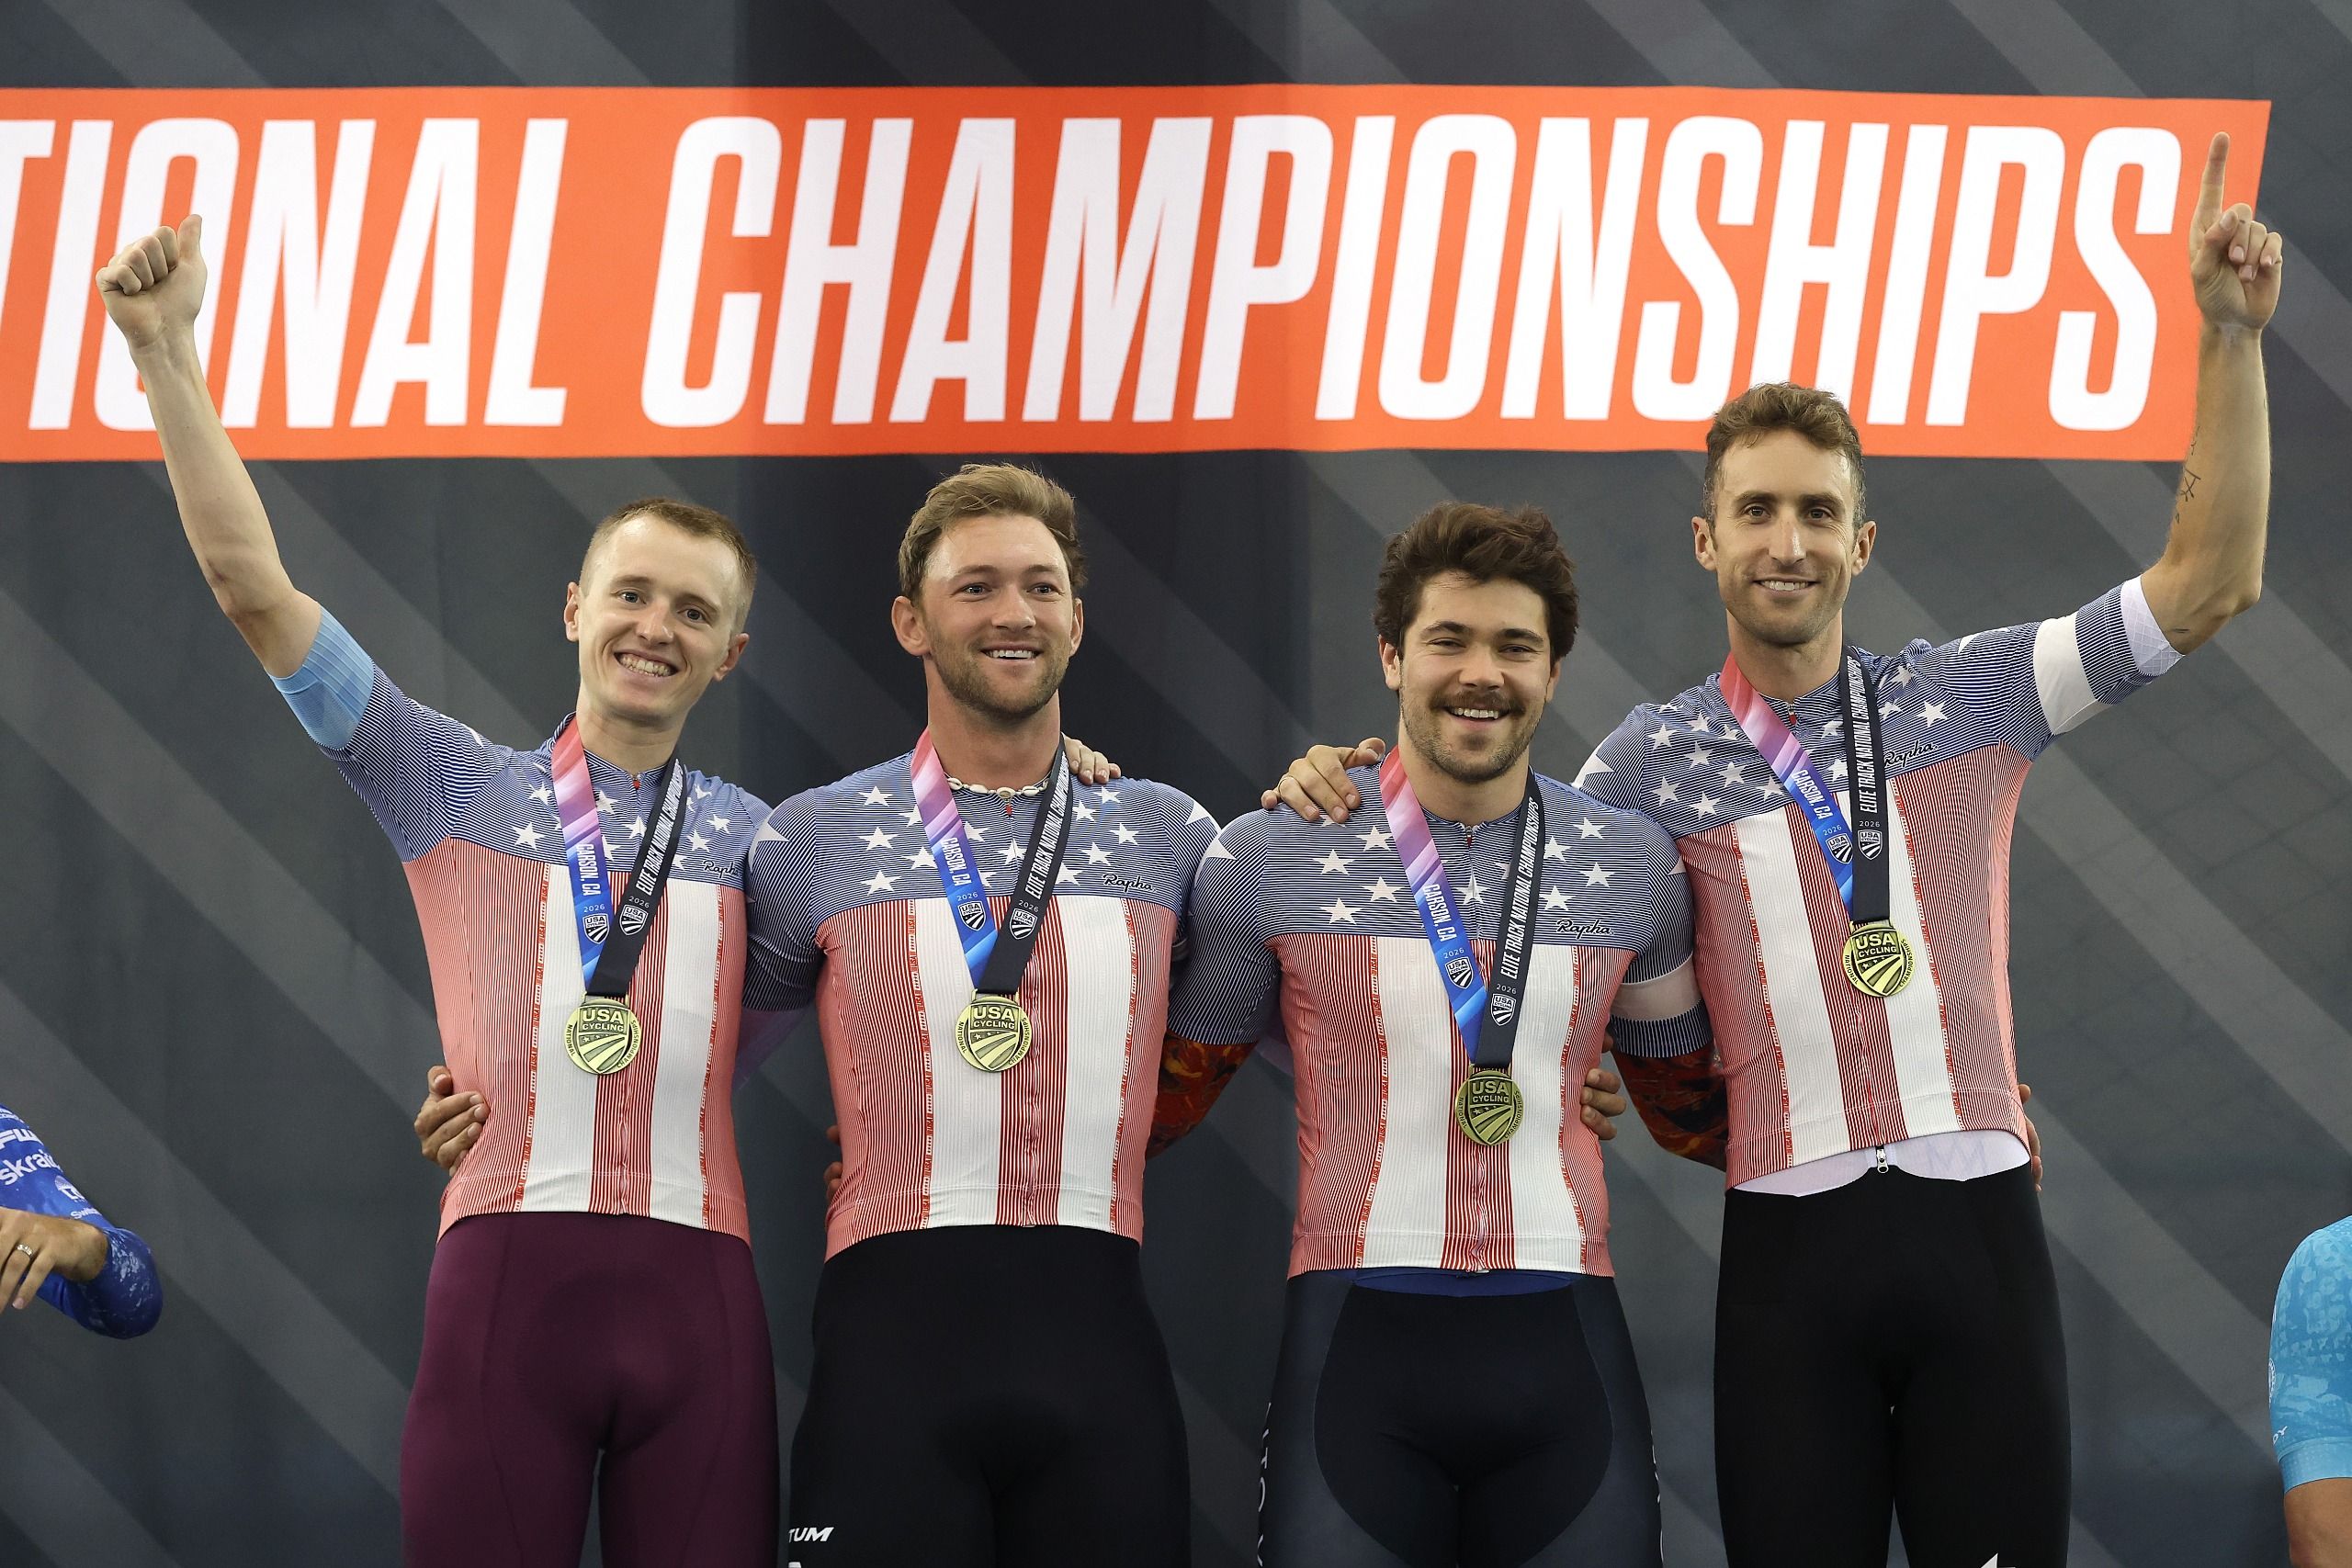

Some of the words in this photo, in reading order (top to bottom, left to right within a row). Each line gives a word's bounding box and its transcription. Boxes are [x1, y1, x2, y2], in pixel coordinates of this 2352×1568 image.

[640, 114, 2182, 432] CHAMPIONSHIPS
[1852, 720, 1873, 760] NATIONAL
[1883, 740, 1934, 768] Rapha
[1050, 750, 1069, 818] CHAMPION
[1856, 759, 1876, 789] TRACK
[662, 758, 684, 821] CHAMPION
[1791, 769, 1826, 807] CARSON,
[1814, 805, 1833, 820] CA
[1859, 790, 1878, 814] ELITE
[651, 813, 674, 854] NATIONAL
[1039, 810, 1064, 852] NATIONAL
[1518, 795, 1540, 879] CHAMPIONSHIPS
[1823, 824, 1842, 836] 2026
[1828, 835, 1848, 845] USA
[1860, 831, 1880, 840] USA
[575, 842, 599, 882] CARSON,
[643, 845, 665, 875] TRACK
[941, 837, 967, 874] CARSON,
[1031, 845, 1054, 878] TRACK
[582, 883, 602, 897] CA
[636, 869, 659, 897] ELITE
[952, 873, 972, 886] CA
[1025, 873, 1046, 900] ELITE
[1102, 873, 1153, 893] Rapha
[583, 904, 605, 914] 2026
[628, 896, 650, 909] 2026
[956, 892, 978, 902] 2026
[961, 903, 980, 912] USA
[1018, 899, 1039, 913] 2026
[1510, 874, 1533, 923] NATIONAL
[585, 916, 605, 924] USA
[625, 907, 644, 919] USA
[1015, 909, 1035, 922] USA
[1422, 883, 1452, 928] CARSON,
[1437, 926, 1457, 942] CA
[1505, 919, 1526, 954] TRACK
[1556, 919, 1611, 940] Rapha
[1855, 932, 1896, 950] USA
[1442, 947, 1464, 960] 2026
[1448, 959, 1467, 971] USA
[1858, 945, 1897, 958] CYCLING
[1899, 939, 1914, 987] CHAMPIONSHIPS
[1500, 952, 1521, 980] ELITE
[1845, 954, 1859, 985] NATIONAL
[1495, 996, 1514, 1008] USA
[1496, 983, 1517, 995] 2026
[582, 1009, 624, 1025] USA
[582, 1022, 624, 1032] CYCLING
[973, 1021, 1015, 1030] CYCLING
[974, 1006, 1015, 1022] USA
[566, 1024, 575, 1057] NATIONAL
[616, 1020, 639, 1069] CHAMPIONSHIPS
[957, 1021, 967, 1055] NATIONAL
[1008, 1018, 1030, 1066] CHAMPIONSHIPS
[1472, 1080, 1510, 1097] USA
[1472, 1095, 1510, 1104] CYCLING
[1458, 1097, 1468, 1129] NATIONAL
[1504, 1090, 1523, 1140] CHAMPIONSHIPS
[0, 1148, 63, 1186] skrat
